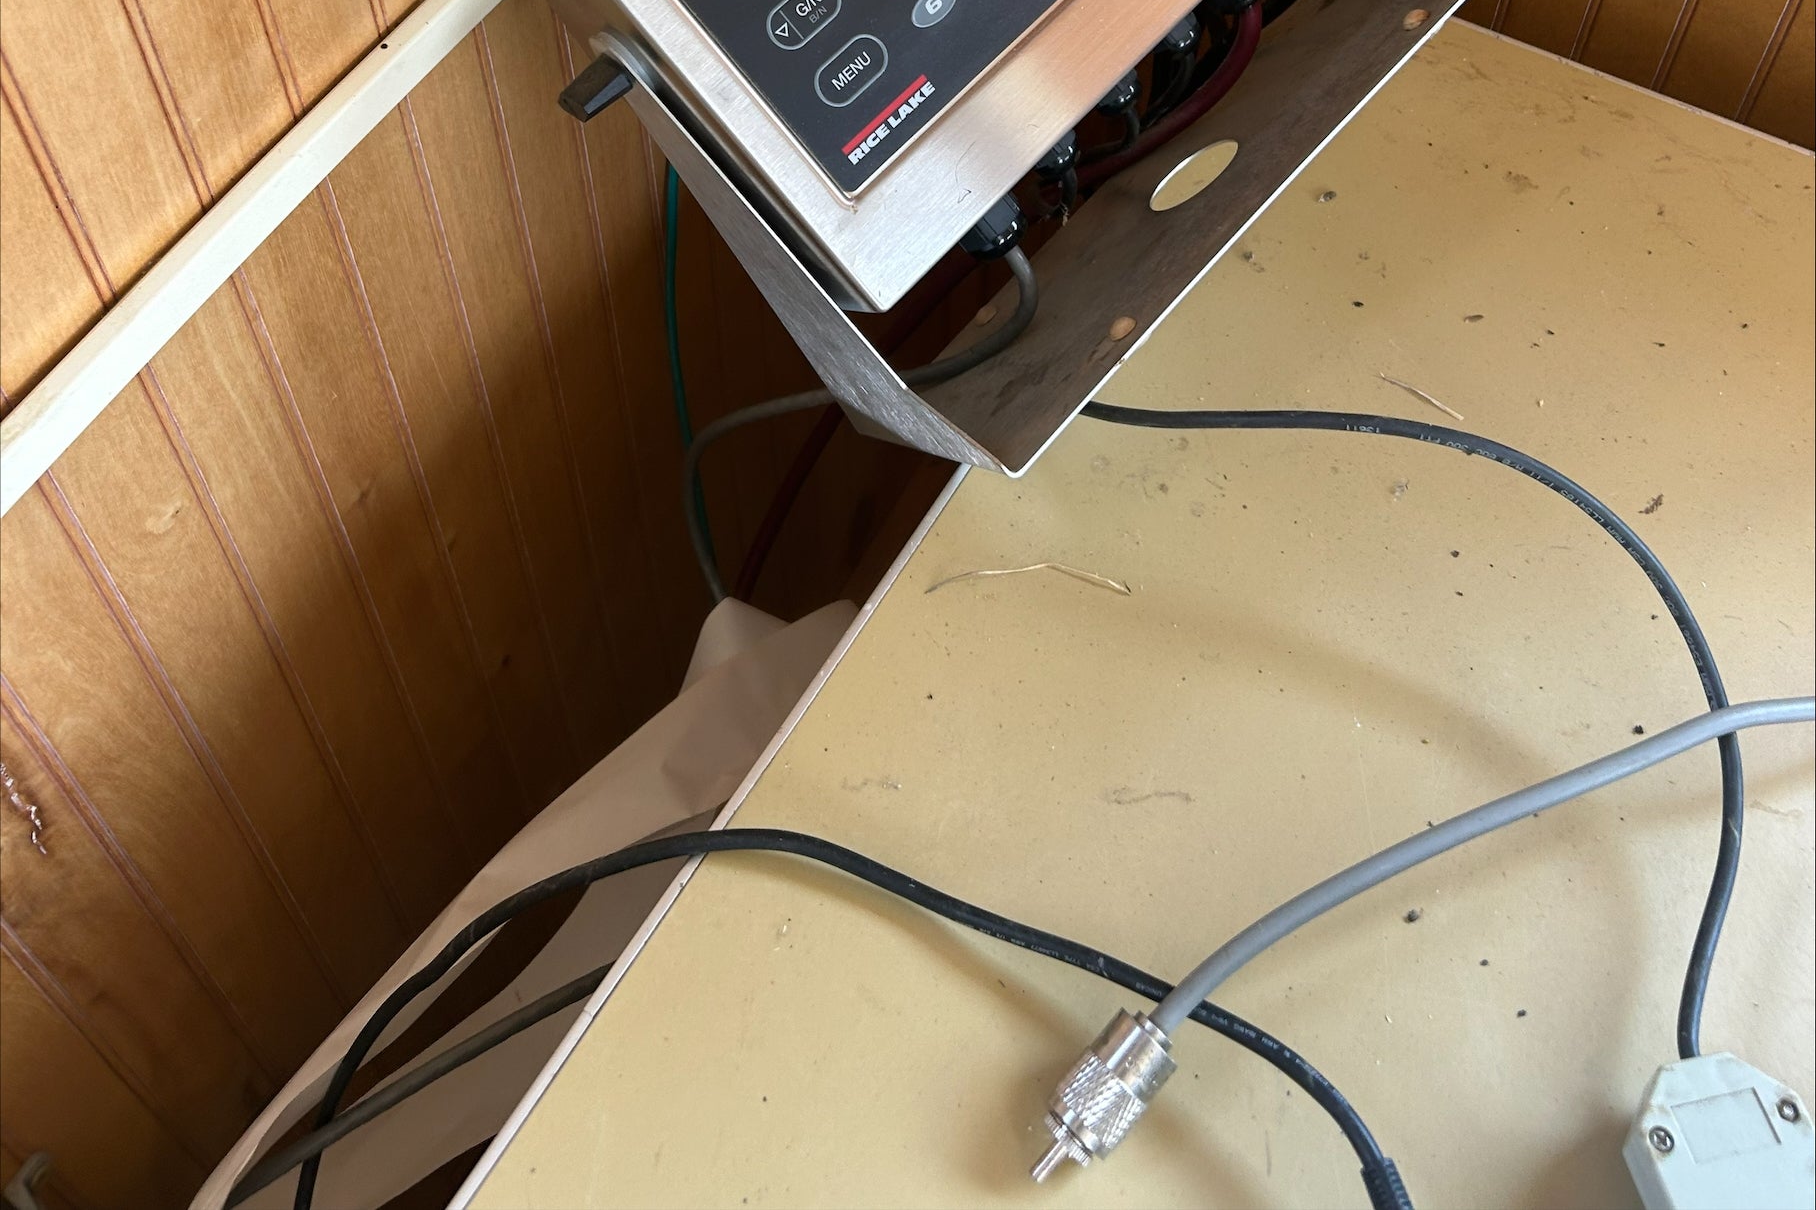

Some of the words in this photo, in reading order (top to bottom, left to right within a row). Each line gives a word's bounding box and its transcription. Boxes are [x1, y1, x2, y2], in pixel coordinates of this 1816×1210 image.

[808, 5, 828, 24] B/N
[831, 51, 872, 91] MENU
[847, 121, 890, 166] RICE
[886, 81, 936, 128] LAKE
